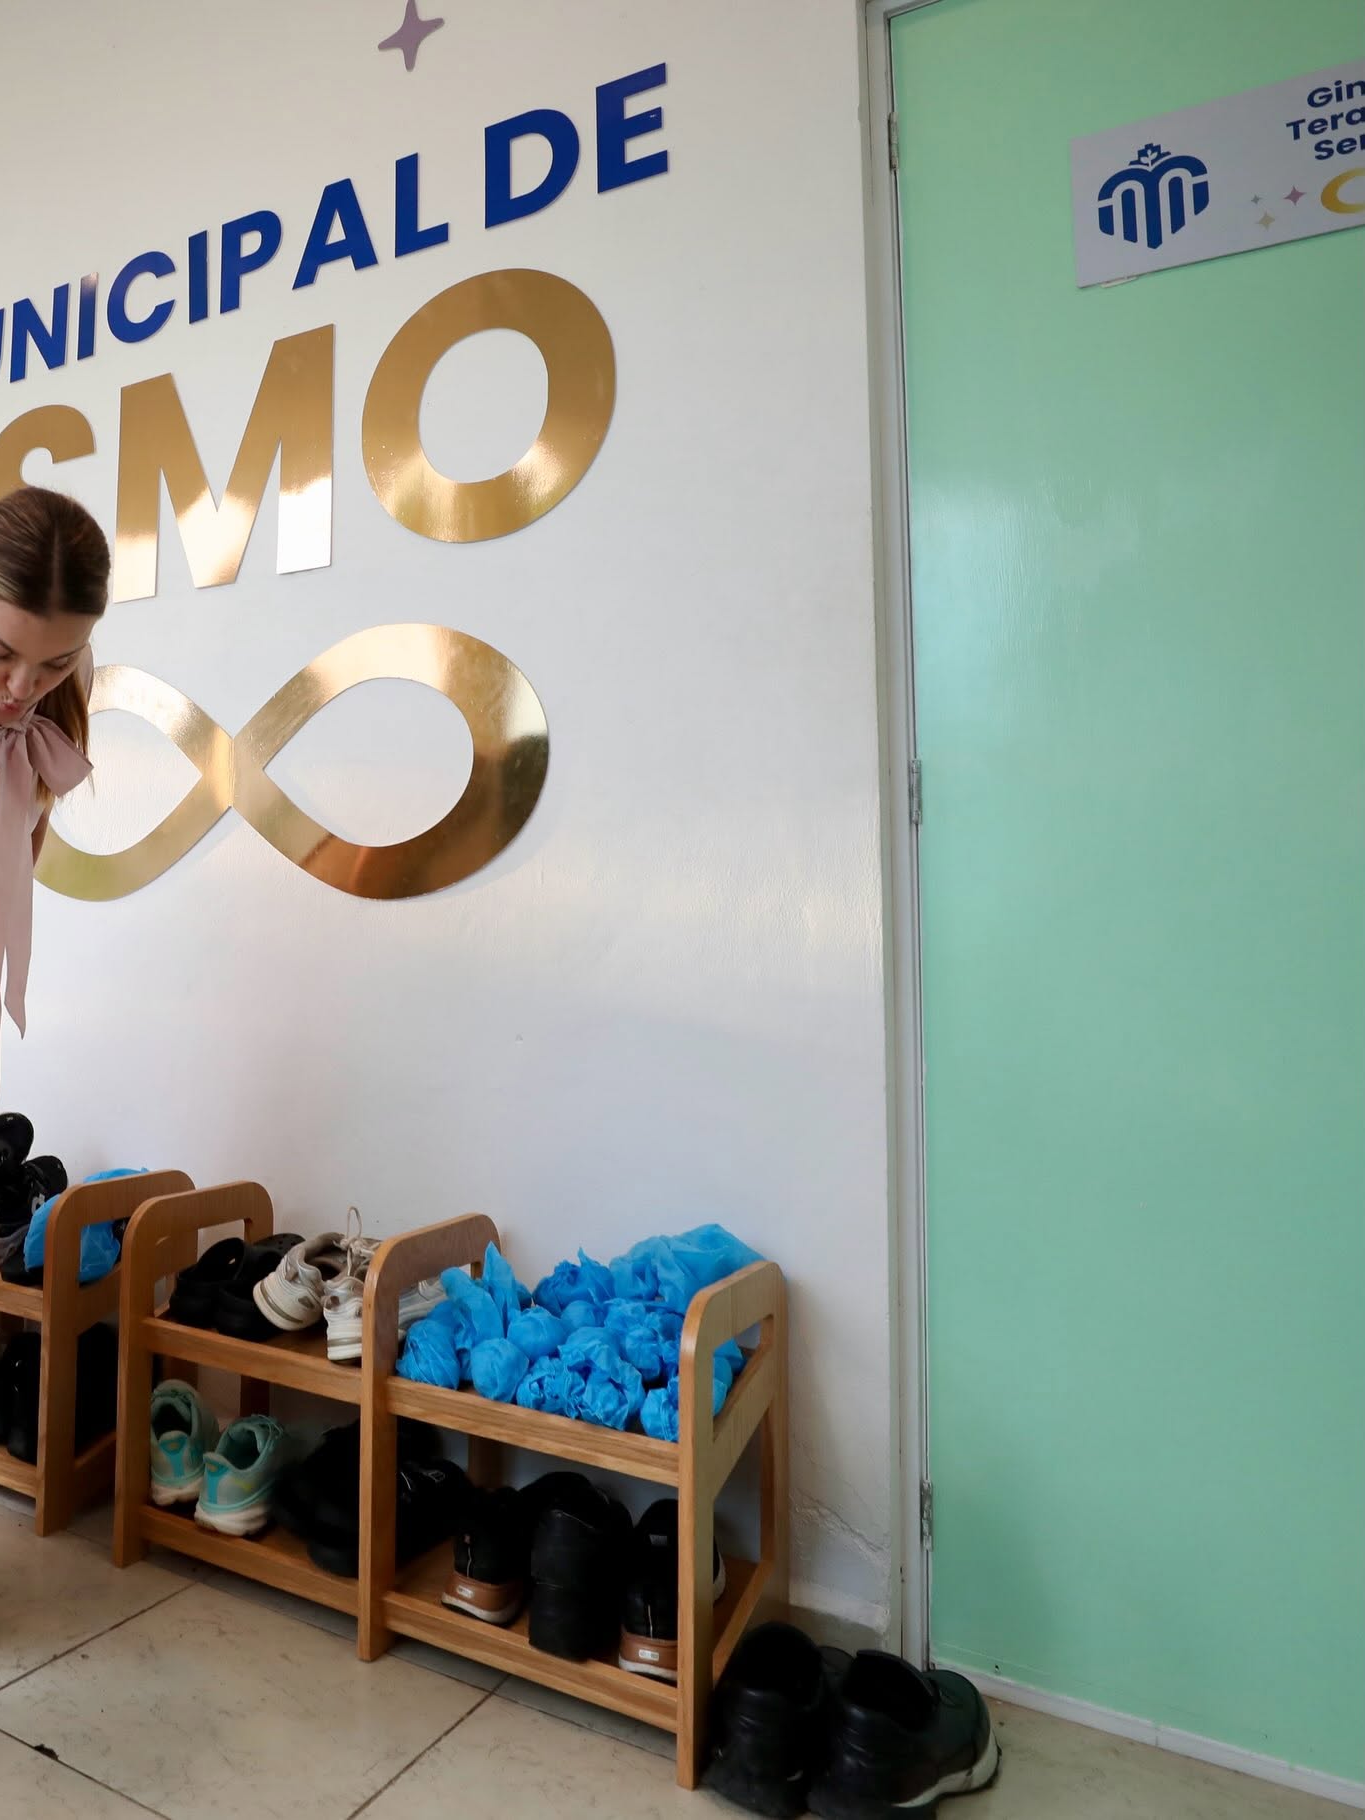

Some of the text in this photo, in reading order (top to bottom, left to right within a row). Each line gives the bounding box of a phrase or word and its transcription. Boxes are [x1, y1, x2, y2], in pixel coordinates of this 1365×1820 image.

[1306, 79, 1365, 108] Gin
[1285, 106, 1365, 141] Tera
[484, 63, 669, 228] DE
